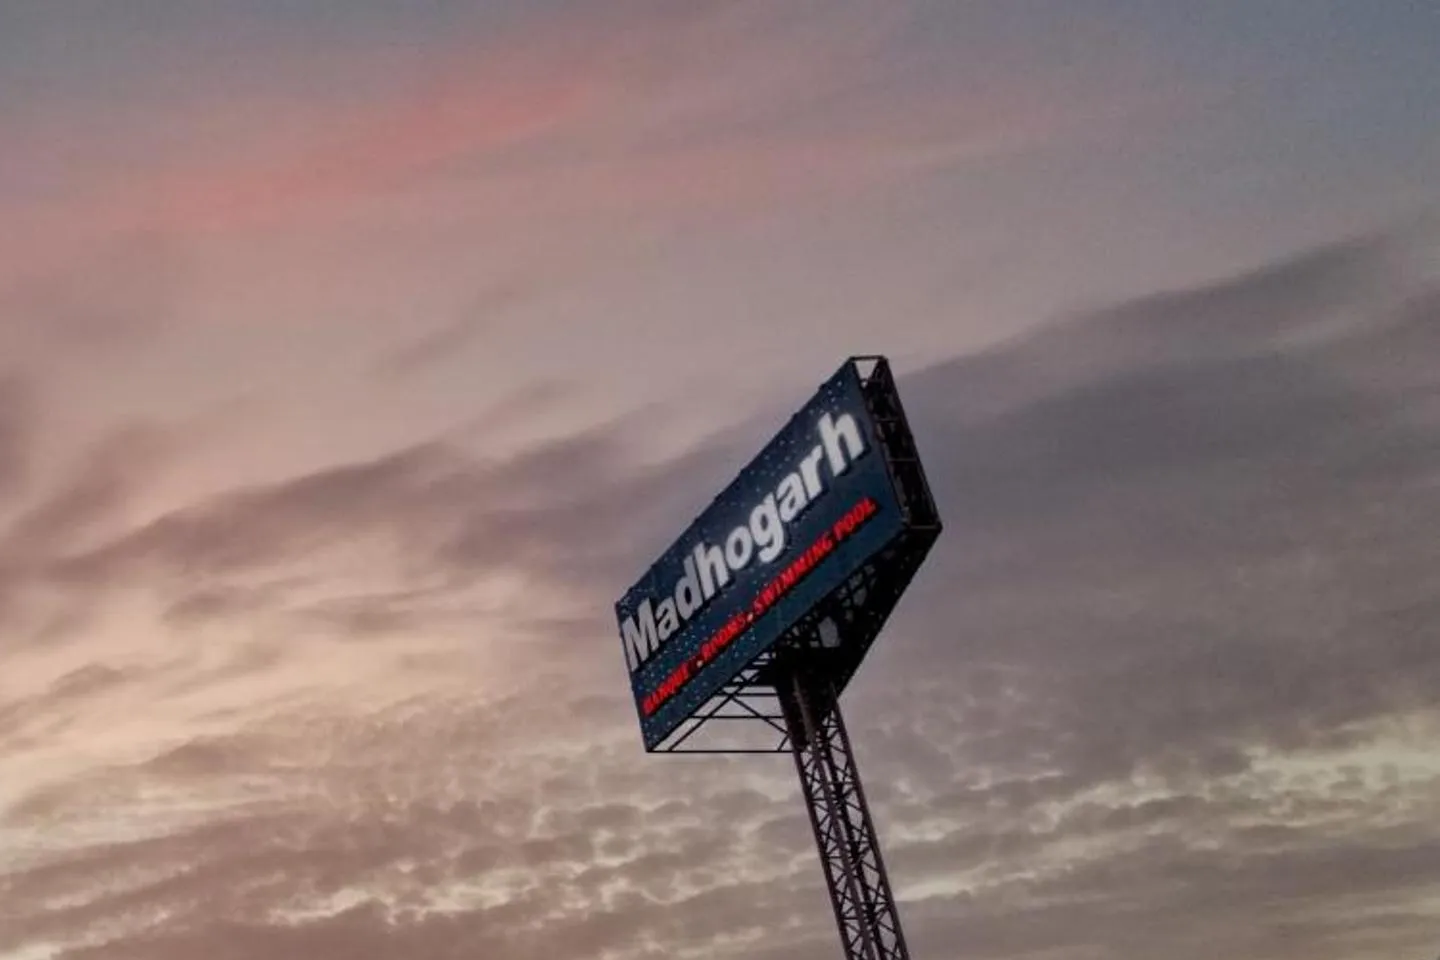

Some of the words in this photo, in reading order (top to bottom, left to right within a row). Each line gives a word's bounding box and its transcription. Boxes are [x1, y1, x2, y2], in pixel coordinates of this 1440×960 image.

[620, 411, 865, 671] Madhogarh
[752, 531, 833, 615] SWIMMING
[833, 498, 877, 541] POOL
